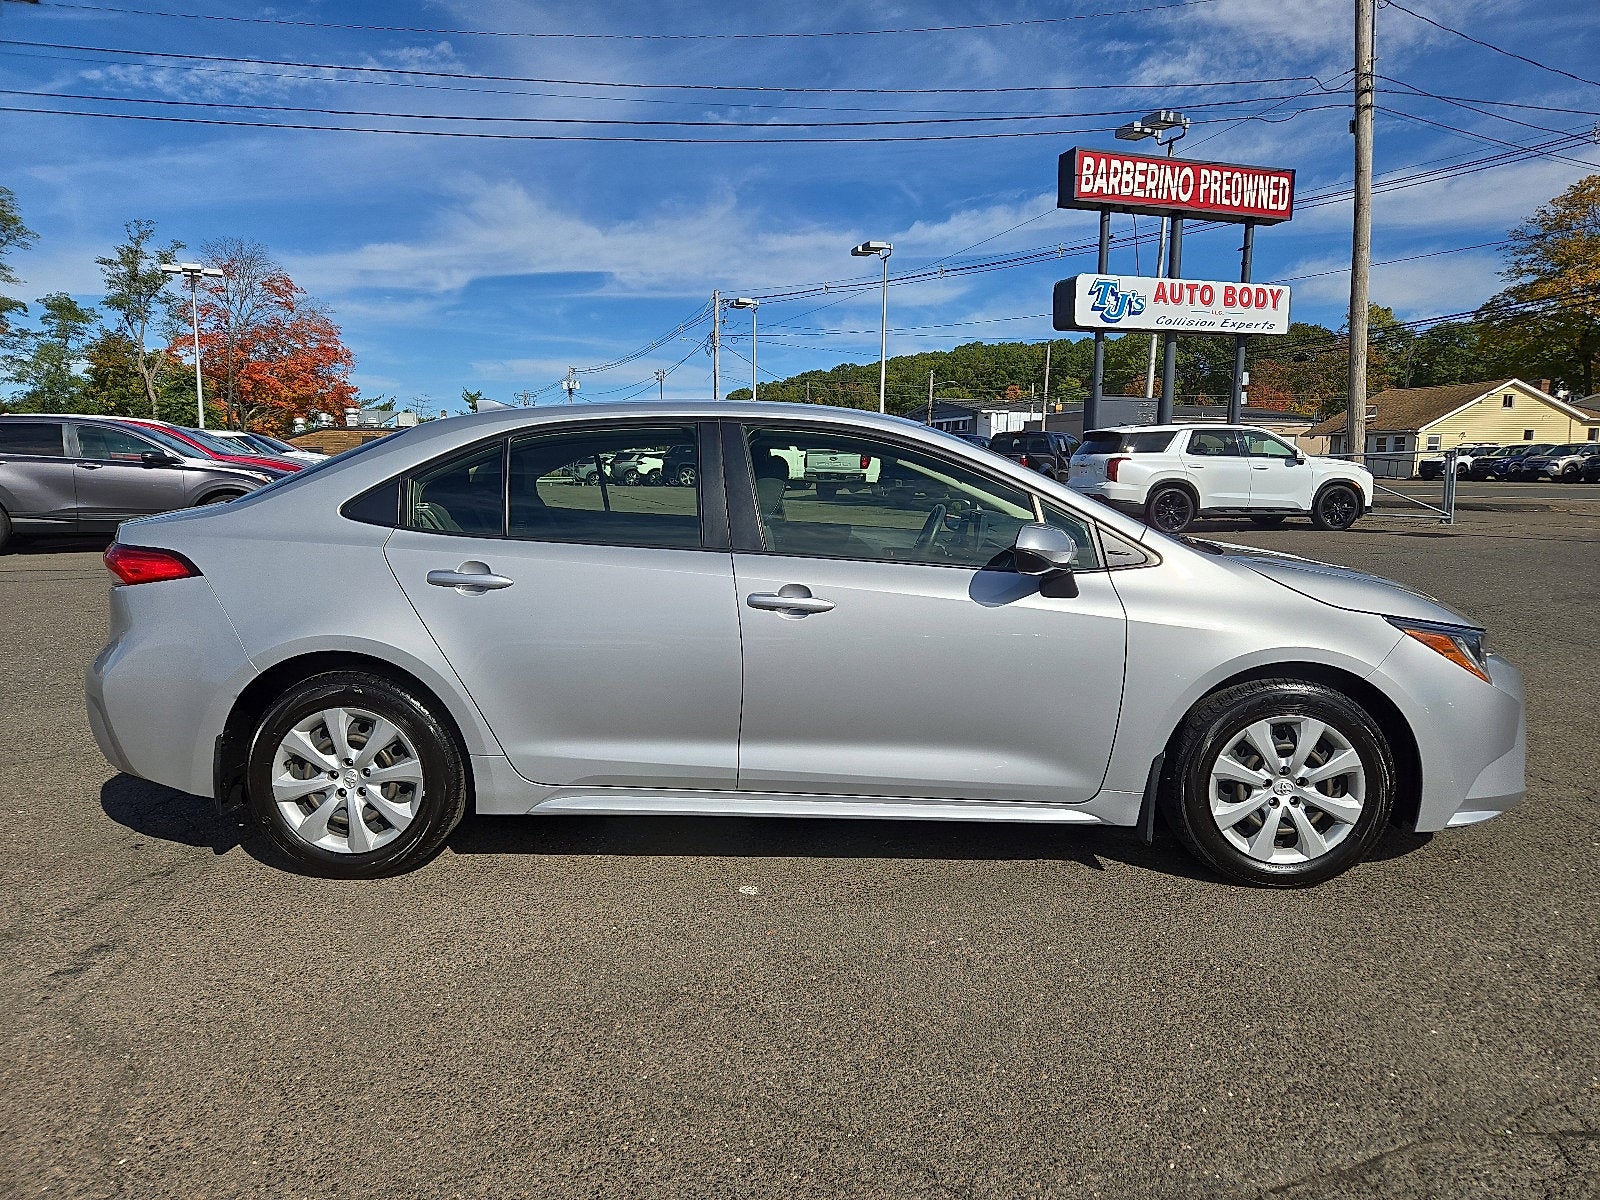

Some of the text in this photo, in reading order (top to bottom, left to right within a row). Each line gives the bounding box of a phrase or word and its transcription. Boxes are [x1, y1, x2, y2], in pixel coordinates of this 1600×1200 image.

[1080, 156, 1290, 211] BARBERINO PREOWNED
[1153, 281, 1283, 311] AUTO BODY
[1155, 315, 1276, 331] Collision Experts
